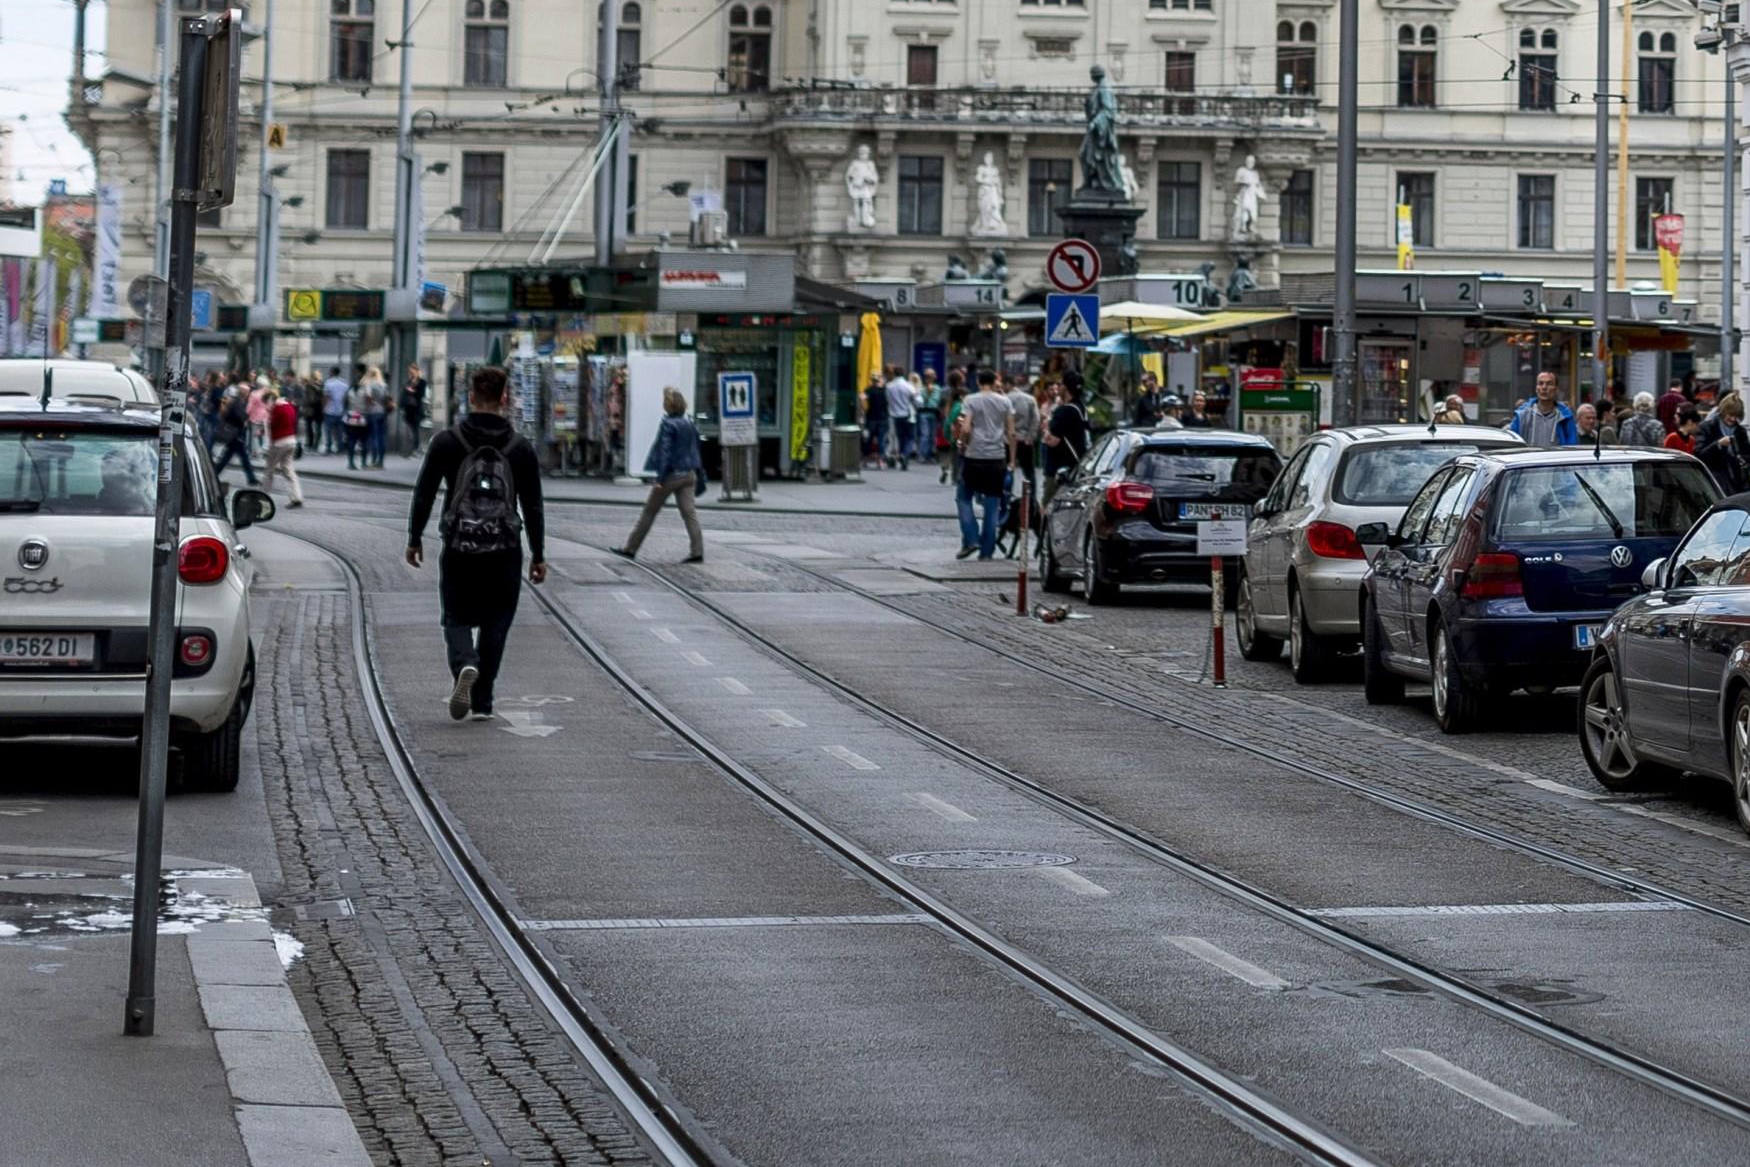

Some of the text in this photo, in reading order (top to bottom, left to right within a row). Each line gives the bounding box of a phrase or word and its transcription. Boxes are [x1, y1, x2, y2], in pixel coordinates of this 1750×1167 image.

[1173, 281, 1198, 303] 10
[1402, 284, 1412, 302] 1
[1459, 283, 1471, 300] 2
[1523, 289, 1534, 306] 3
[1562, 295, 1573, 310] 4
[1658, 300, 1668, 315] 6
[1682, 308, 1691, 321] 7
